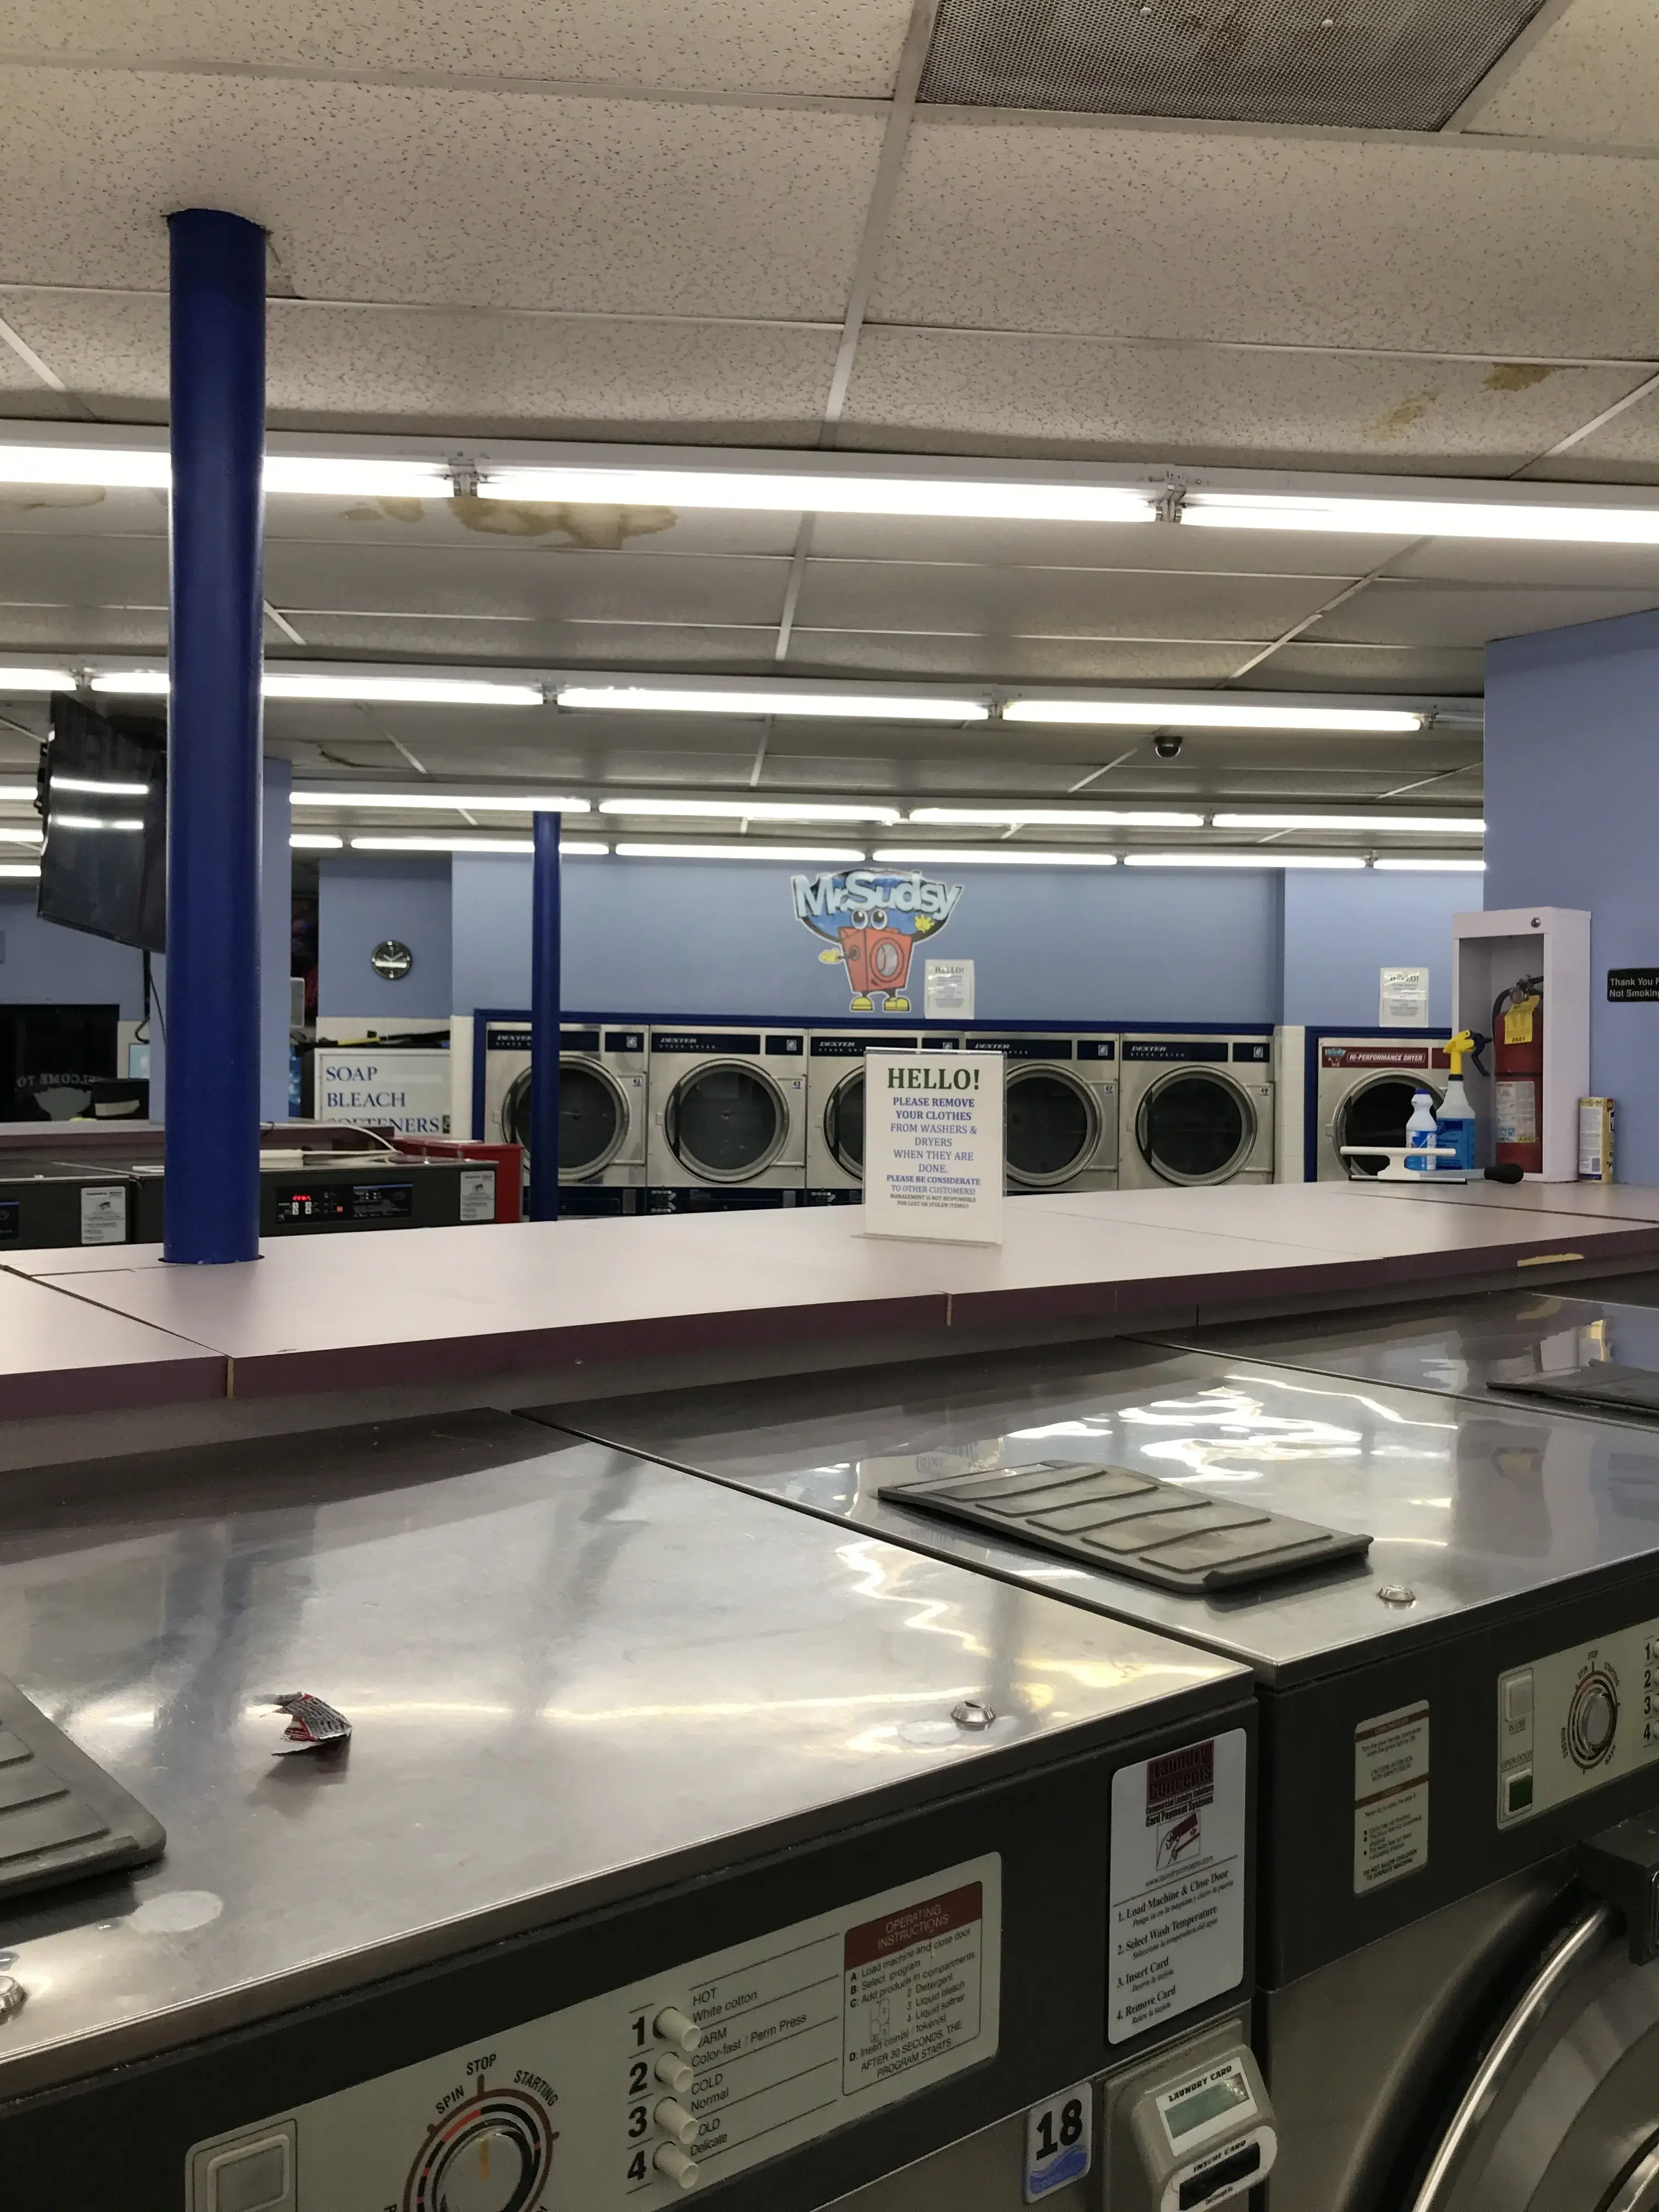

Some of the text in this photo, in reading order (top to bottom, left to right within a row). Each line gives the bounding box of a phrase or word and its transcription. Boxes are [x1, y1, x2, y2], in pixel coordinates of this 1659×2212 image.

[1610, 978, 1635, 986] Thank
[1638, 977, 1652, 986] You
[1610, 989, 1623, 997] Not
[326, 1066, 377, 1081] SOAP
[887, 1068, 979, 1090] HELLO!
[327, 1091, 405, 1108] BLEACH
[893, 1097, 975, 1107] PLEASE REMOVE
[890, 1124, 977, 1135] FROM WASHERS &
[896, 1110, 972, 1121] YOUR CLOTHES
[893, 1149, 974, 1161] WHEN THEY ARE
[915, 1137, 952, 1147] DRYERS
[918, 1164, 948, 1173] DONE.
[927, 1177, 980, 1186] CONSIDERATE
[902, 1185, 927, 1193] OTHER
[929, 1186, 975, 1194] CUSTOMERS!
[1645, 1643, 1650, 1661] 1
[1644, 1669, 1651, 1689] 2
[1644, 1696, 1651, 1714] 3
[1643, 1723, 1650, 1740] 4
[1161, 1804, 1187, 1821] Payment
[1188, 1795, 1214, 1812] Systems
[1118, 1870, 1229, 1922] 1. Load Machine & Close Door
[878, 1914, 949, 1949] INSTRUCTIONS
[886, 1904, 941, 1933] OPERATING
[1126, 1934, 1148, 1951] Select
[1150, 1925, 1170, 1940] Wash
[1172, 1906, 1217, 1931] Temperature
[861, 1928, 970, 1978] Load machine and close door
[861, 1976, 885, 1990] Select
[889, 1960, 921, 1980] program
[861, 1990, 877, 2003] Add
[879, 1976, 912, 1999] products
[921, 1951, 975, 1979] compartments
[1126, 1966, 1148, 1984] Insert
[1150, 1956, 1169, 1973] Card
[693, 1988, 717, 2006] HOT
[906, 1973, 953, 1997] 2 Detergent
[906, 1980, 965, 2011] 3 Liquid bleach
[692, 1991, 757, 2023] White cotton
[907, 1993, 965, 2023] 4 Liquid softner
[1116, 1985, 1176, 2021] 4. Remove Card
[632, 2016, 645, 2046] 1
[691, 2039, 741, 2067] Color-fast
[751, 2025, 777, 2043] Perm
[780, 2014, 807, 2032] Press
[860, 2041, 882, 2057] Insert
[884, 2028, 909, 2047] coin(s)
[916, 2013, 947, 2033] token(s)
[861, 2020, 962, 2072] AFTER 30 THE
[877, 2038, 952, 2078] PROGRAM STARTS
[466, 2053, 496, 2075] STOP
[514, 2069, 559, 2106] STARTING
[629, 2062, 648, 2096] 2
[691, 2073, 723, 2095] COLD
[1167, 2065, 1232, 2102] LAUNDRY CARD
[436, 2085, 465, 2114] SPIN
[691, 2087, 729, 2112] Normal
[628, 2106, 647, 2137] 3
[1036, 2098, 1083, 2160] 18
[690, 2132, 727, 2156] Delicate
[1193, 2140, 1246, 2172] INSERT CARD
[627, 2151, 647, 2180] 4
